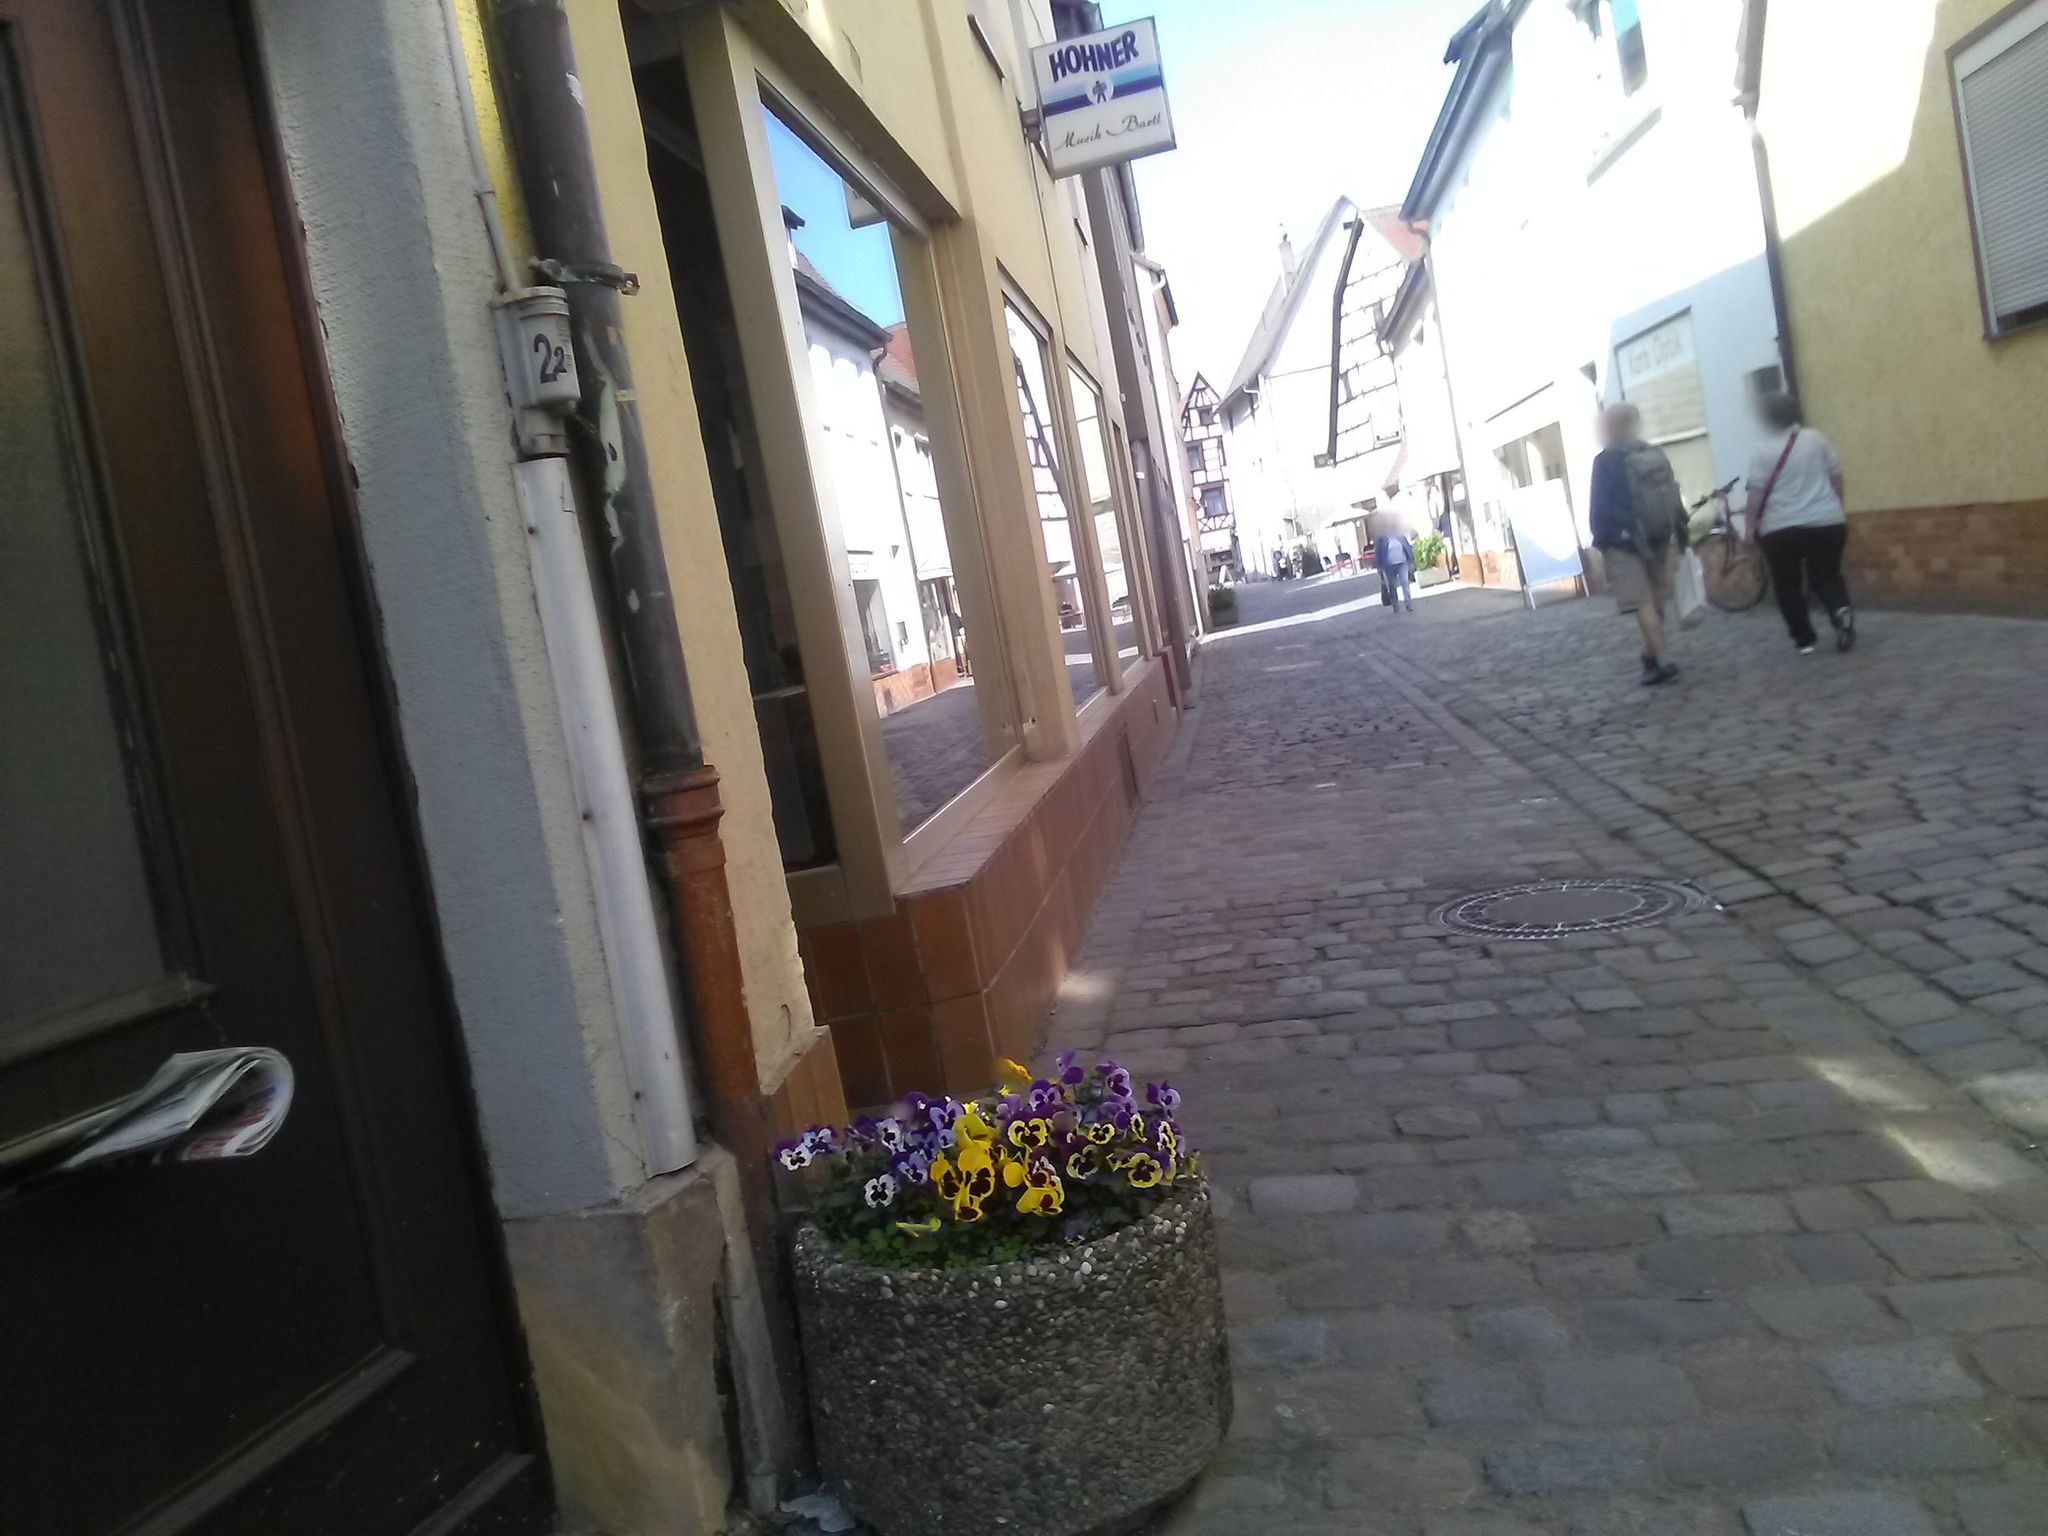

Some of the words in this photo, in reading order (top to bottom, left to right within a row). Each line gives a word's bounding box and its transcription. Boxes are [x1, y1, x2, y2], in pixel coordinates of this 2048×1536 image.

[1049, 30, 1139, 83] HOHNER
[1054, 123, 1102, 152] Musik
[533, 333, 568, 384] 22
